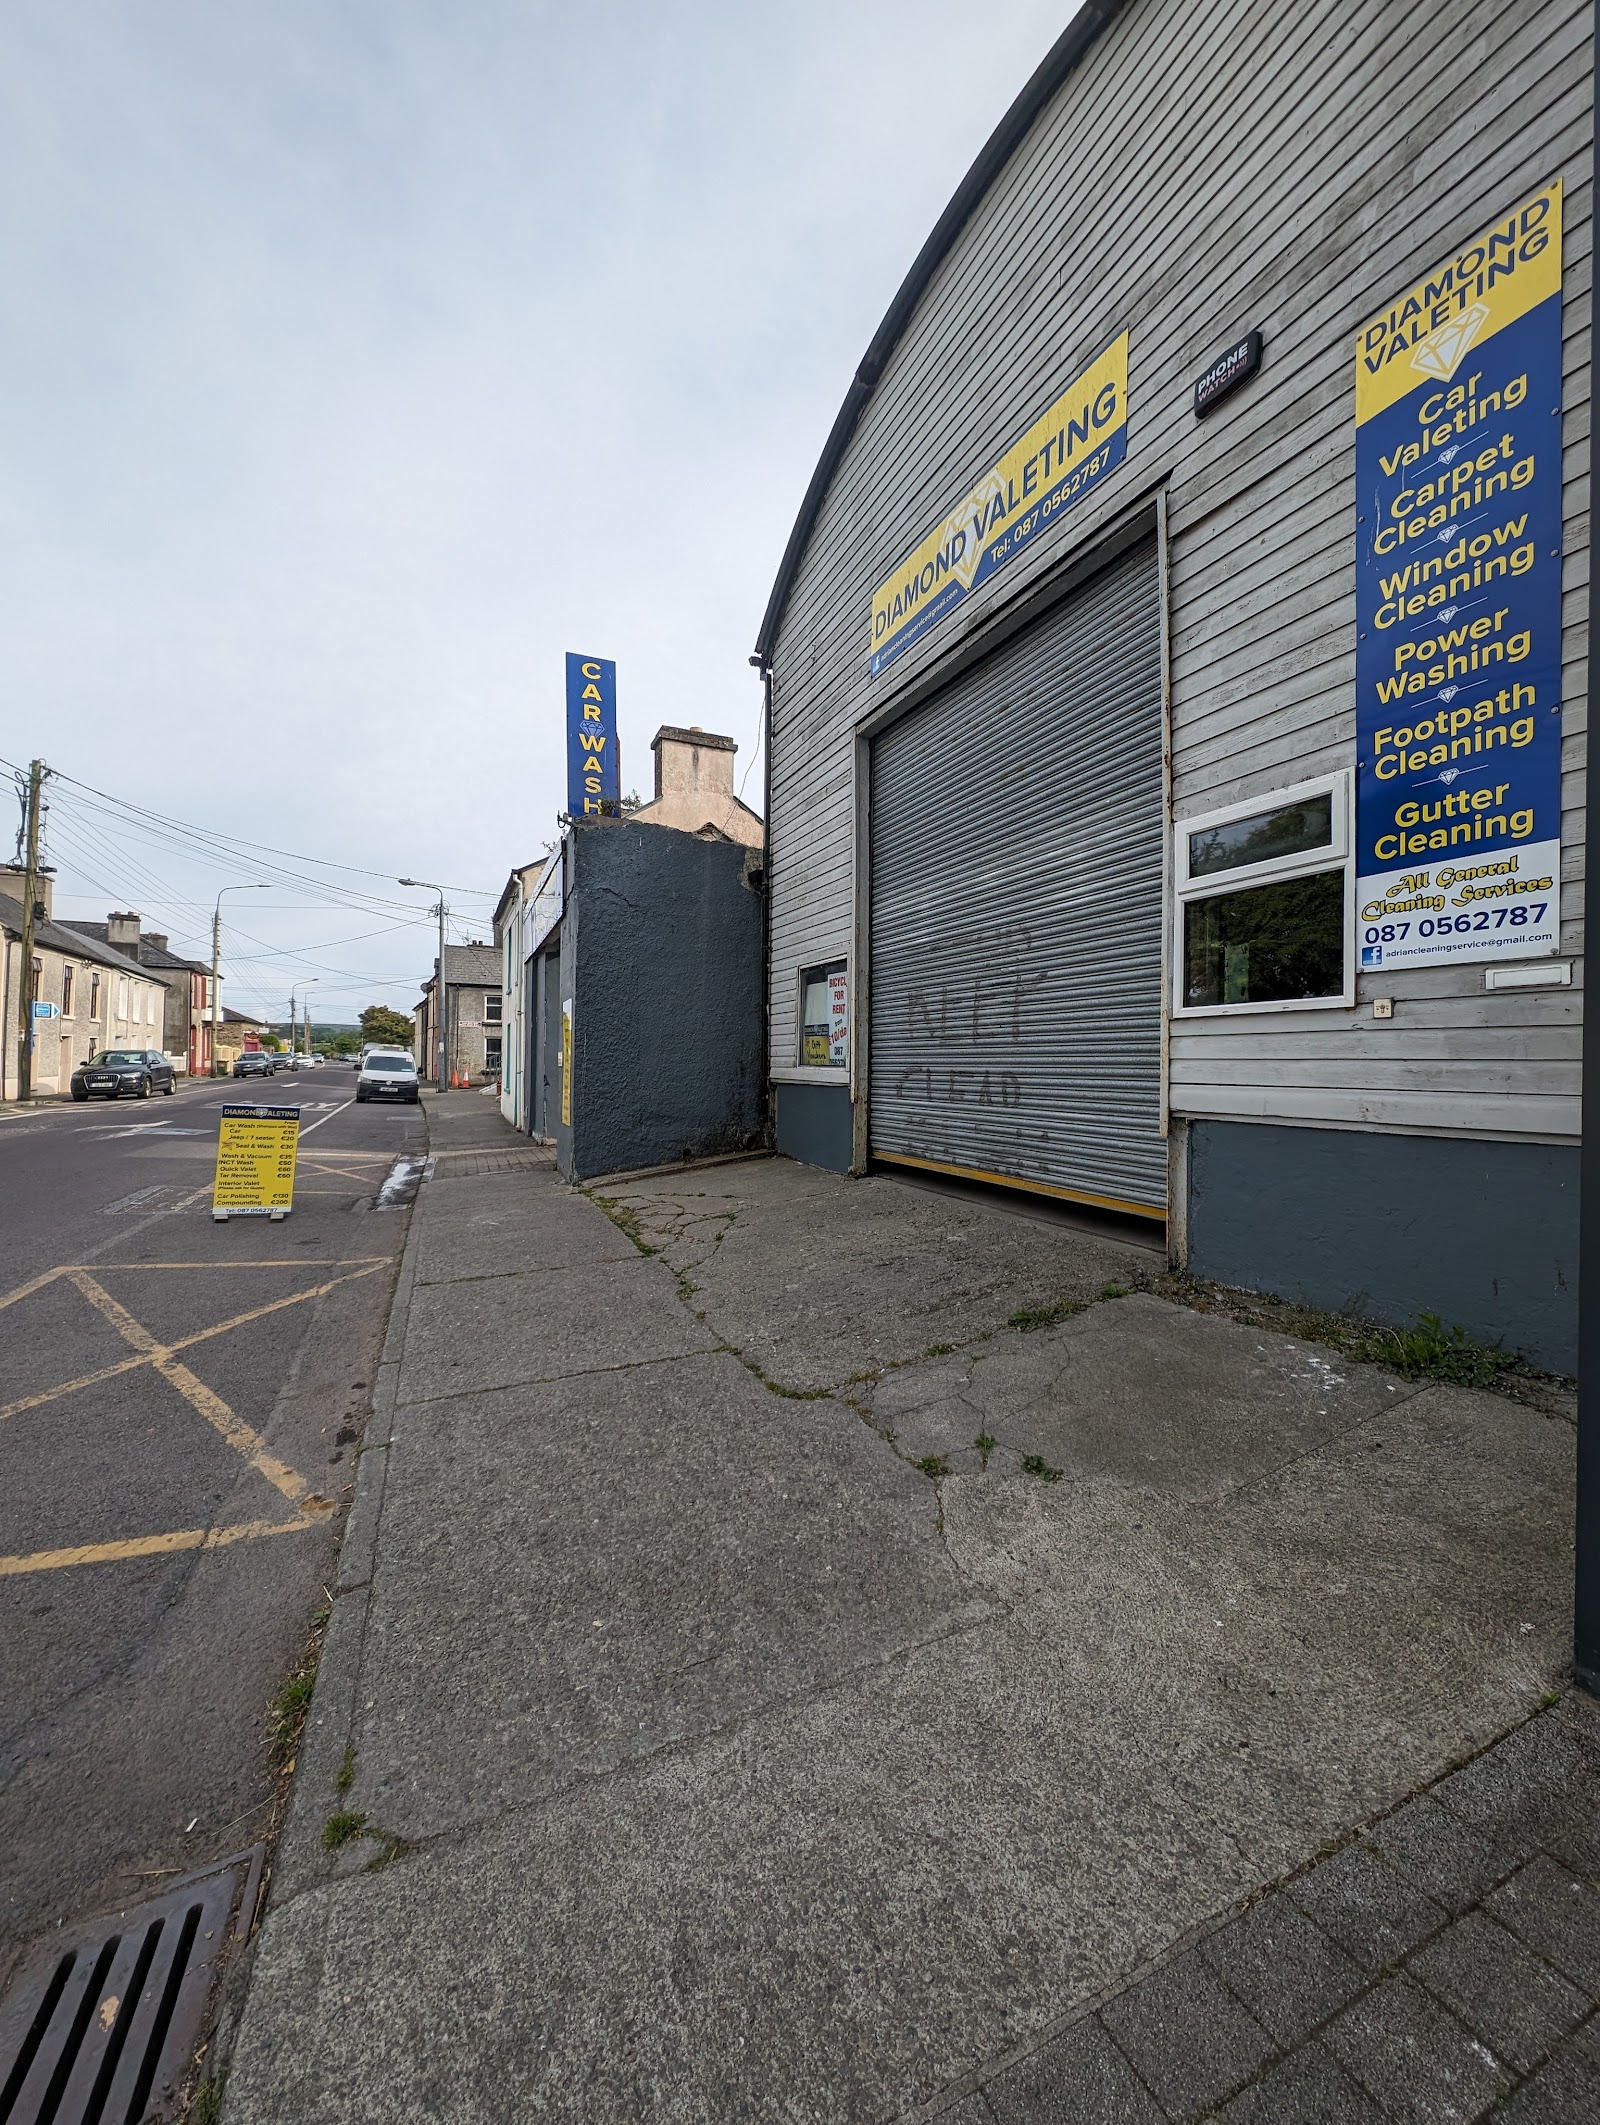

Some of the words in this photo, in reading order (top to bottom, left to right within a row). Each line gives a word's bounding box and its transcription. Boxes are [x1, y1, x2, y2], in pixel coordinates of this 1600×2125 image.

[1364, 227, 1548, 374] VALETING
[1366, 198, 1549, 352] DIAMOND
[1198, 342, 1248, 394] PHONE
[1198, 366, 1235, 402] WATCH
[1418, 371, 1482, 424] Car
[1378, 373, 1527, 477] Valeting
[990, 539, 1011, 563] Tel:
[1014, 513, 1039, 541] 087
[1042, 446, 1110, 516] 0562787
[1374, 455, 1535, 555] Cleaning
[1390, 433, 1514, 518] Carpet
[875, 529, 967, 640] DIAMOND
[973, 382, 1116, 540] VALETING
[1374, 542, 1535, 630] Cleaning
[1378, 513, 1528, 600] Window
[1376, 630, 1531, 704] Washing
[1394, 608, 1509, 671] Power
[581, 662, 602, 723] CAR
[1374, 683, 1536, 755] Footpath
[578, 733, 606, 815] WASH
[1374, 716, 1535, 780] Cleaning
[1374, 808, 1535, 860] Cleaning
[1394, 783, 1509, 828] Gutter
[1361, 894, 1445, 921] Cleaning
[1451, 876, 1553, 907] Services
[1386, 871, 1430, 898] All
[1436, 854, 1519, 889] General
[1365, 922, 1411, 944] 087
[1419, 903, 1548, 937] 0562787
[1385, 933, 1552, 958] adriancleaningservice@gmail.com
[829, 976, 847, 987] BICYCL
[832, 1003, 845, 1015] RENT
[834, 990, 844, 1000] FOR
